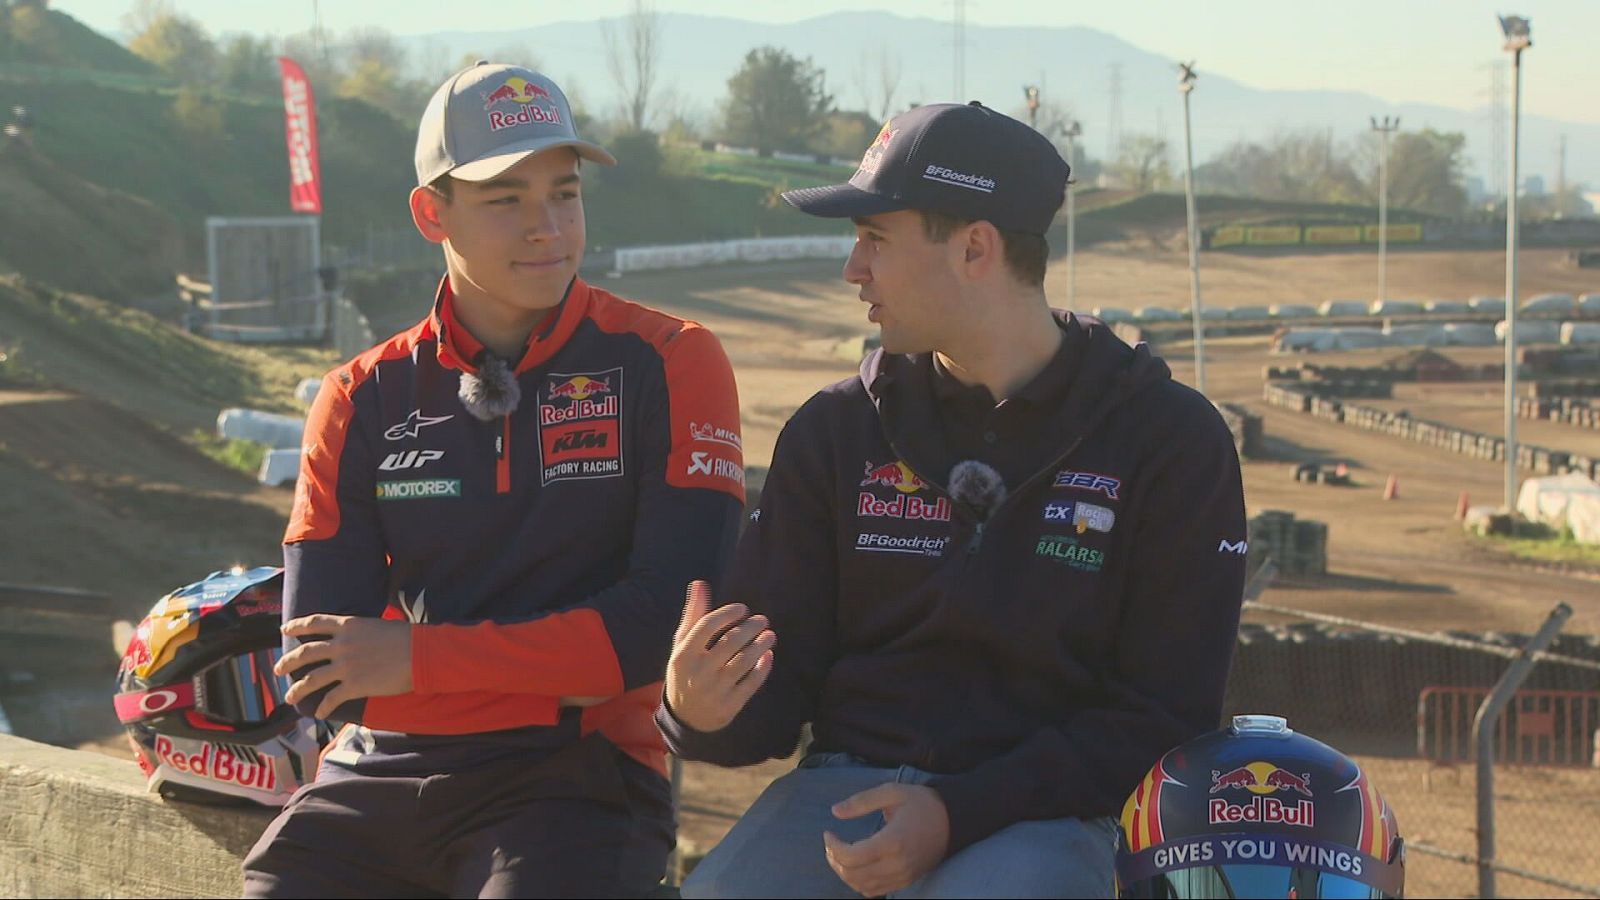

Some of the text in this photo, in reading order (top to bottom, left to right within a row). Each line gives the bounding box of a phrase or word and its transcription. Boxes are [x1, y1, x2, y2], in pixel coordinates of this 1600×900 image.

[489, 104, 563, 131] Red Bull
[925, 165, 996, 189] BFGoodrich
[540, 395, 618, 425] Red Bull
[552, 429, 609, 454] KTM
[378, 450, 445, 471] WP
[544, 460, 619, 480] FACTORY RACING
[384, 480, 457, 497] MOTOREX
[857, 492, 951, 521] Red Bull
[155, 733, 277, 791] Red Bull
[1209, 796, 1314, 828] Red Bull
[1154, 840, 1362, 876] GIVES YOU WINGS
